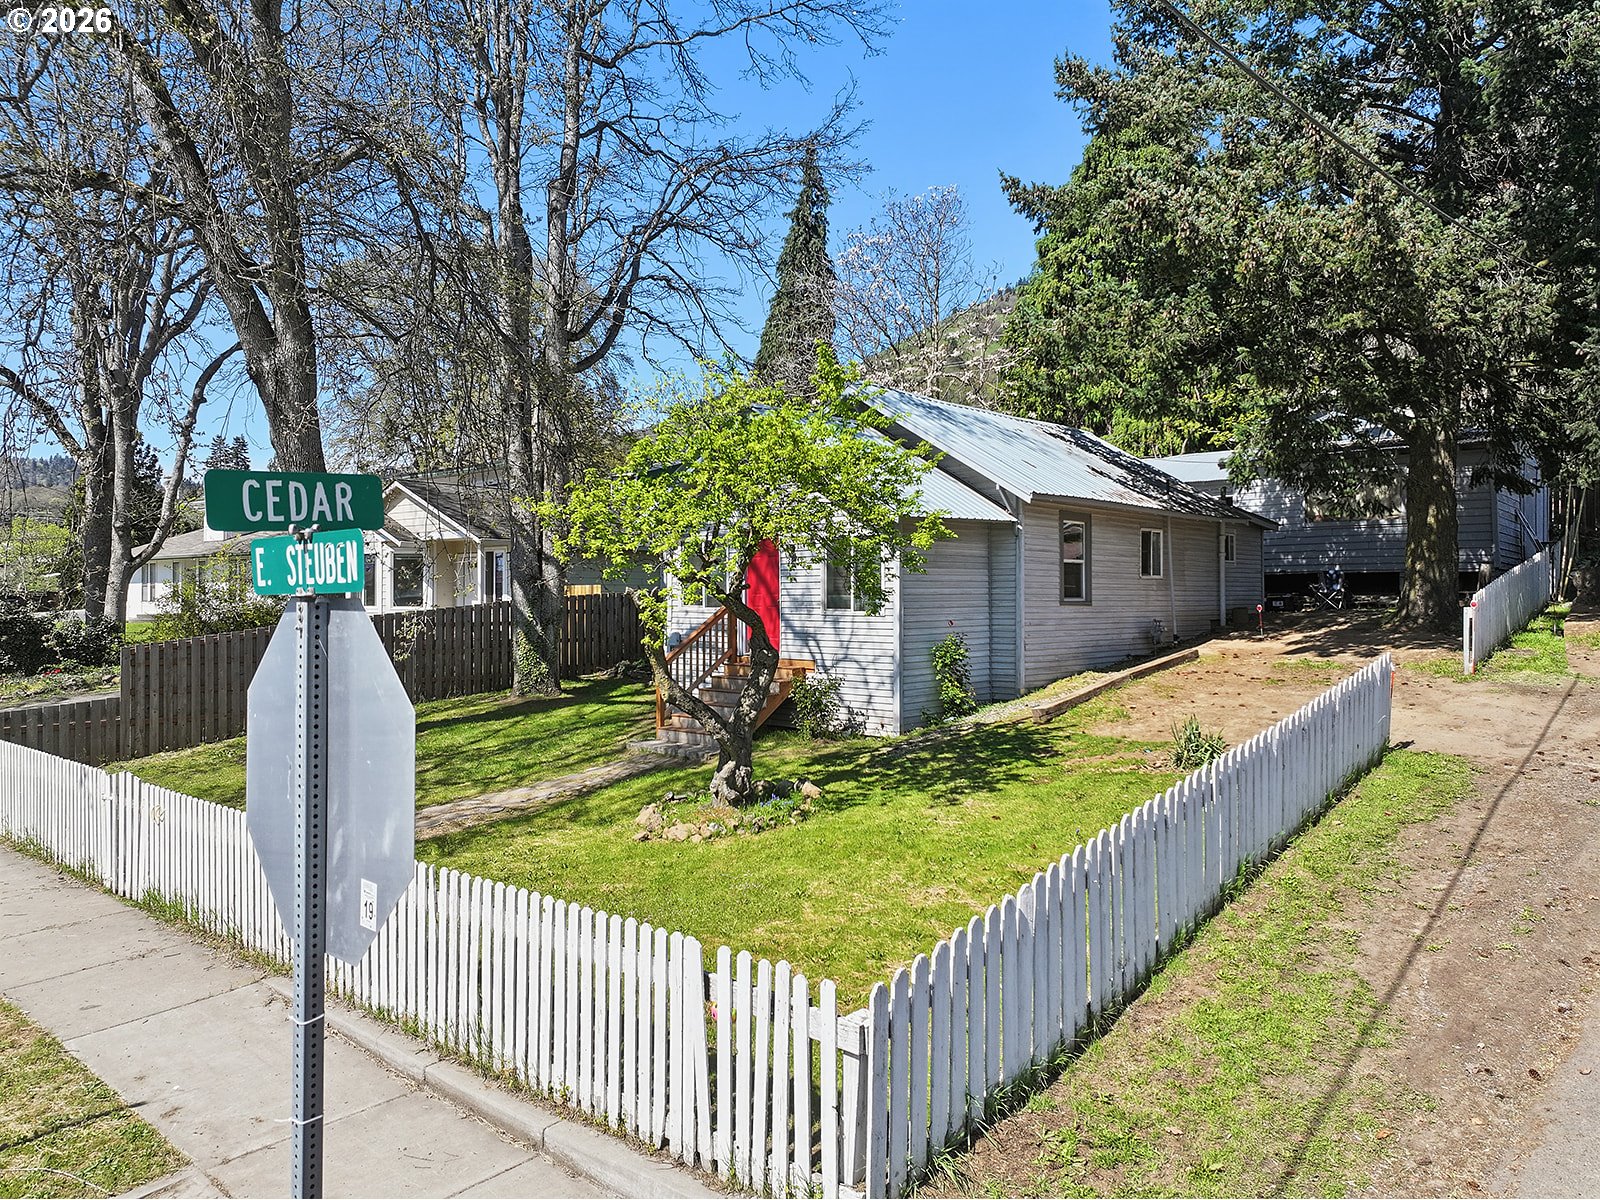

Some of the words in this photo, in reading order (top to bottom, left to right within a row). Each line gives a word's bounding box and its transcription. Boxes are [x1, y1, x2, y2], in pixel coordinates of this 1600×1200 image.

[242, 479, 354, 522] CEDAR
[256, 548, 272, 587] E.
[286, 540, 358, 587] STEUBEN
[364, 900, 374, 920] 19
